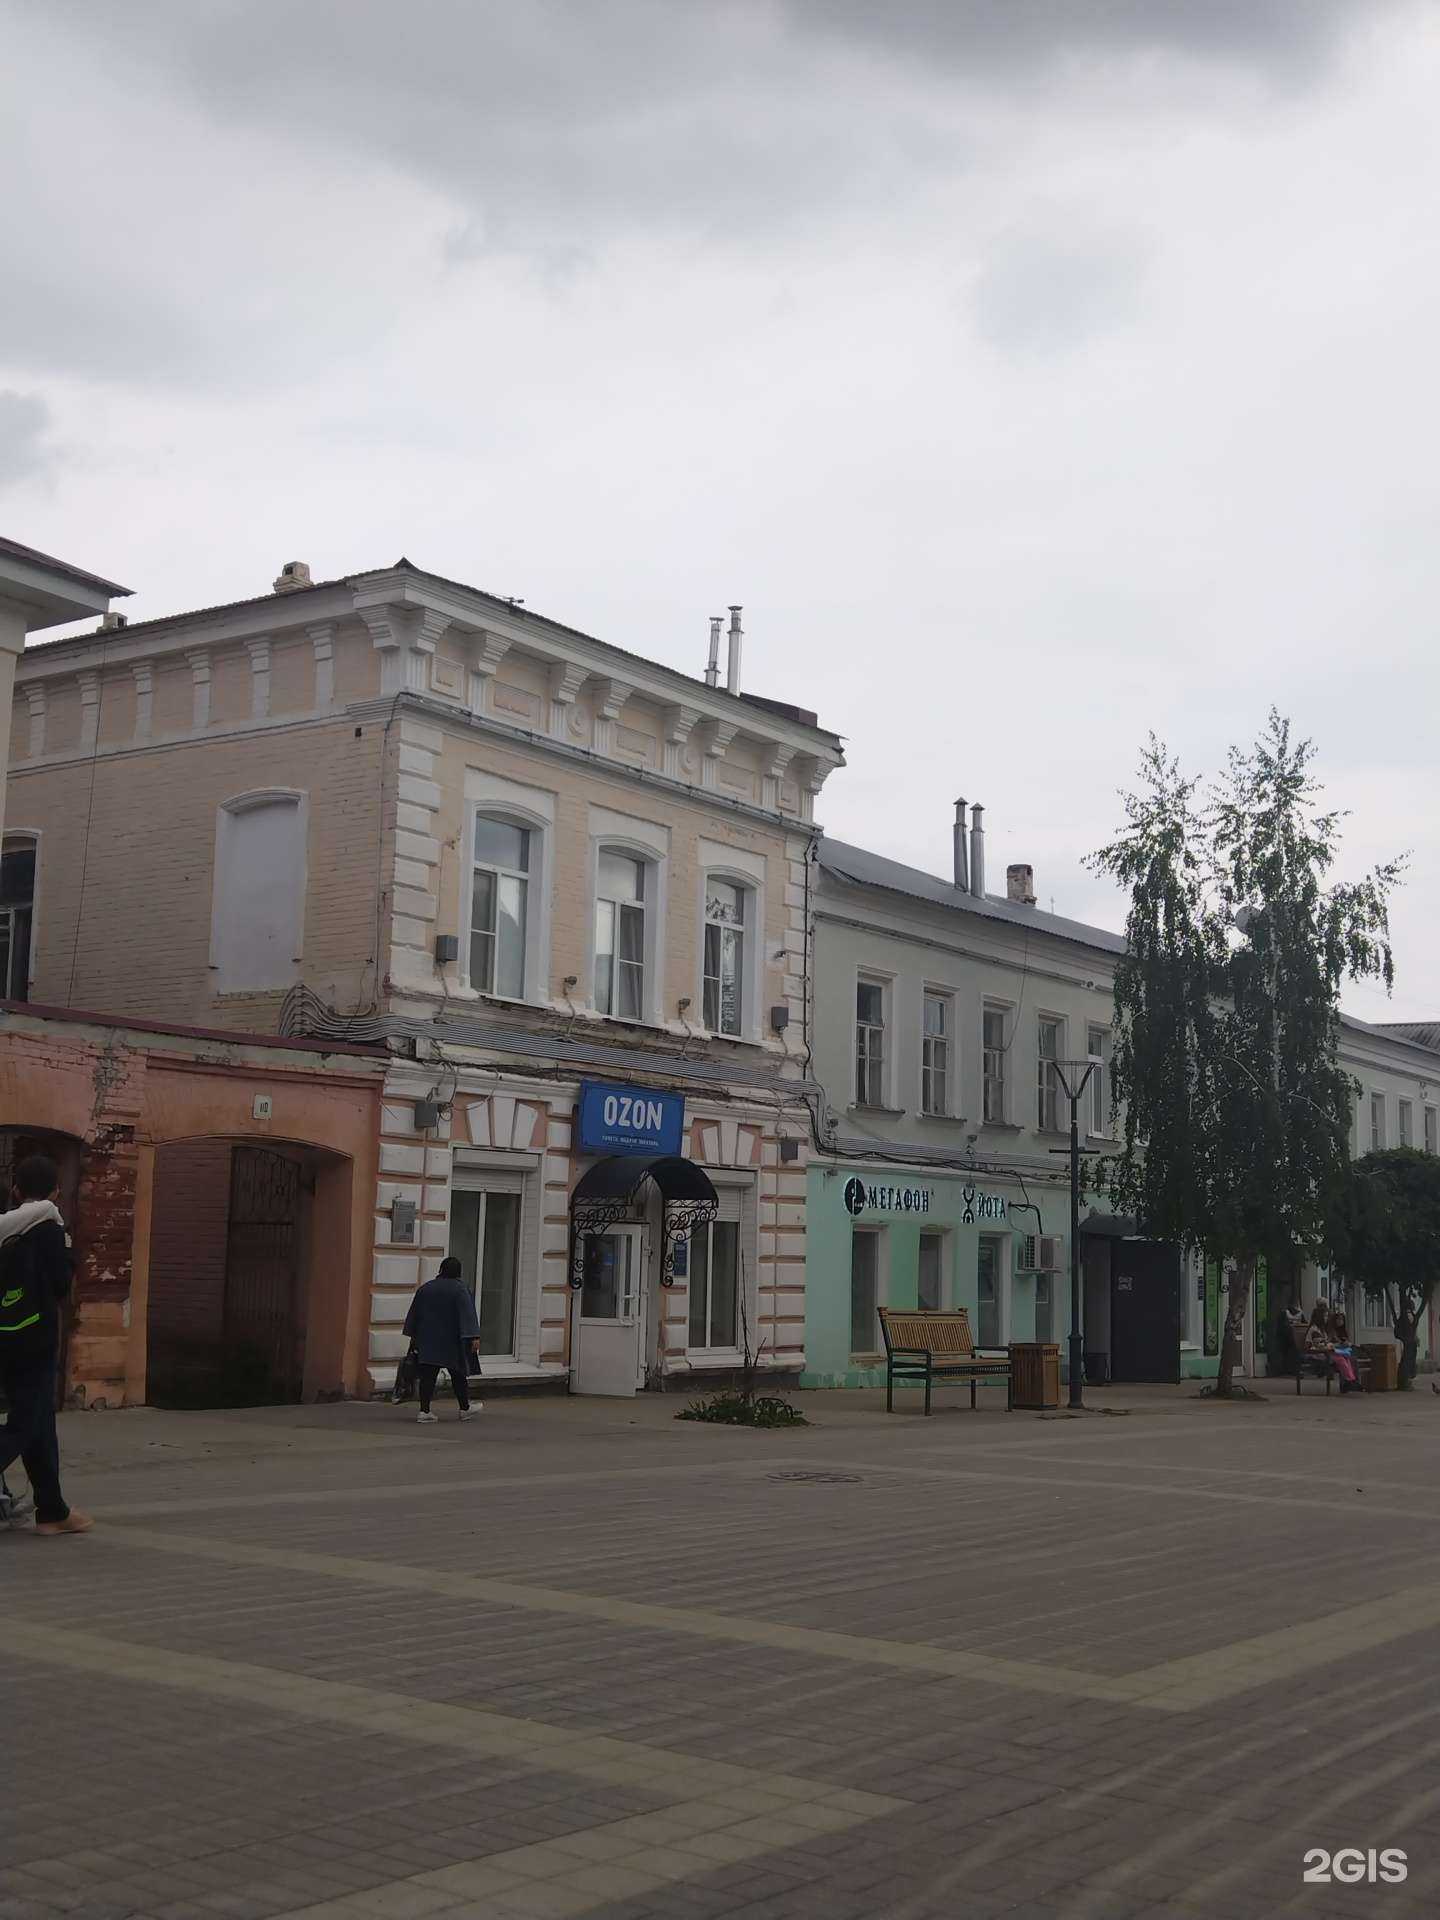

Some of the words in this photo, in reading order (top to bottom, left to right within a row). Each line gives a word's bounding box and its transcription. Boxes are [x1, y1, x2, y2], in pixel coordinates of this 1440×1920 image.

[604, 1096, 663, 1130] OZON
[868, 1185, 930, 1212] МЕГАФОН
[978, 1192, 1006, 1218] ЙОТА
